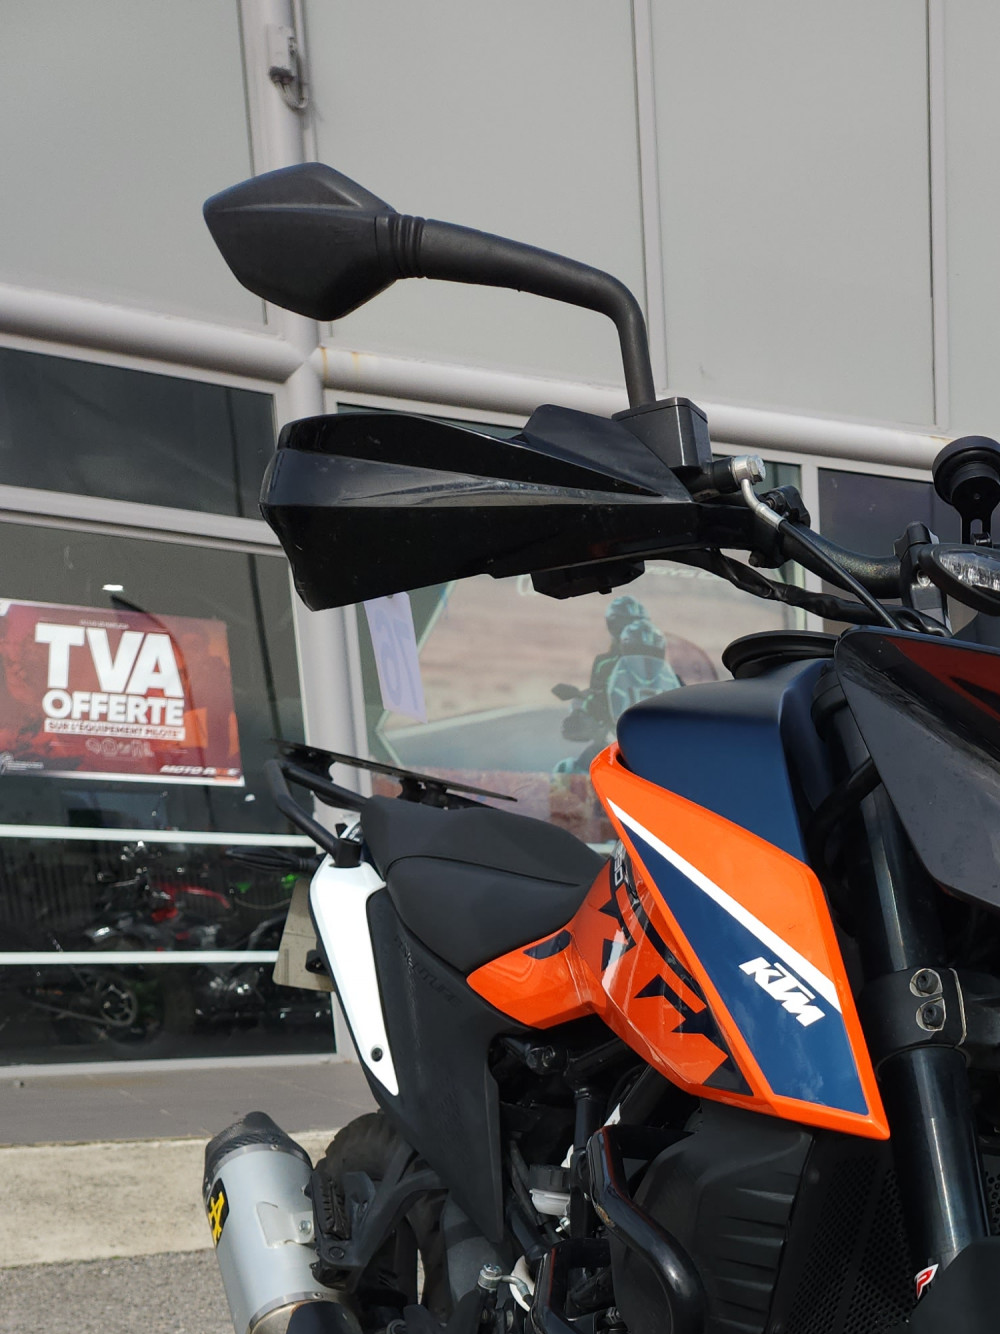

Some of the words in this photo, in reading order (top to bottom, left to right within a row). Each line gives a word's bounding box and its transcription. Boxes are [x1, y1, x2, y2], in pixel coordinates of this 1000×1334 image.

[35, 622, 185, 698] TVA
[42, 688, 185, 727] OFFERTE
[160, 765, 203, 775] MOTO
[738, 956, 826, 1027] KTM
